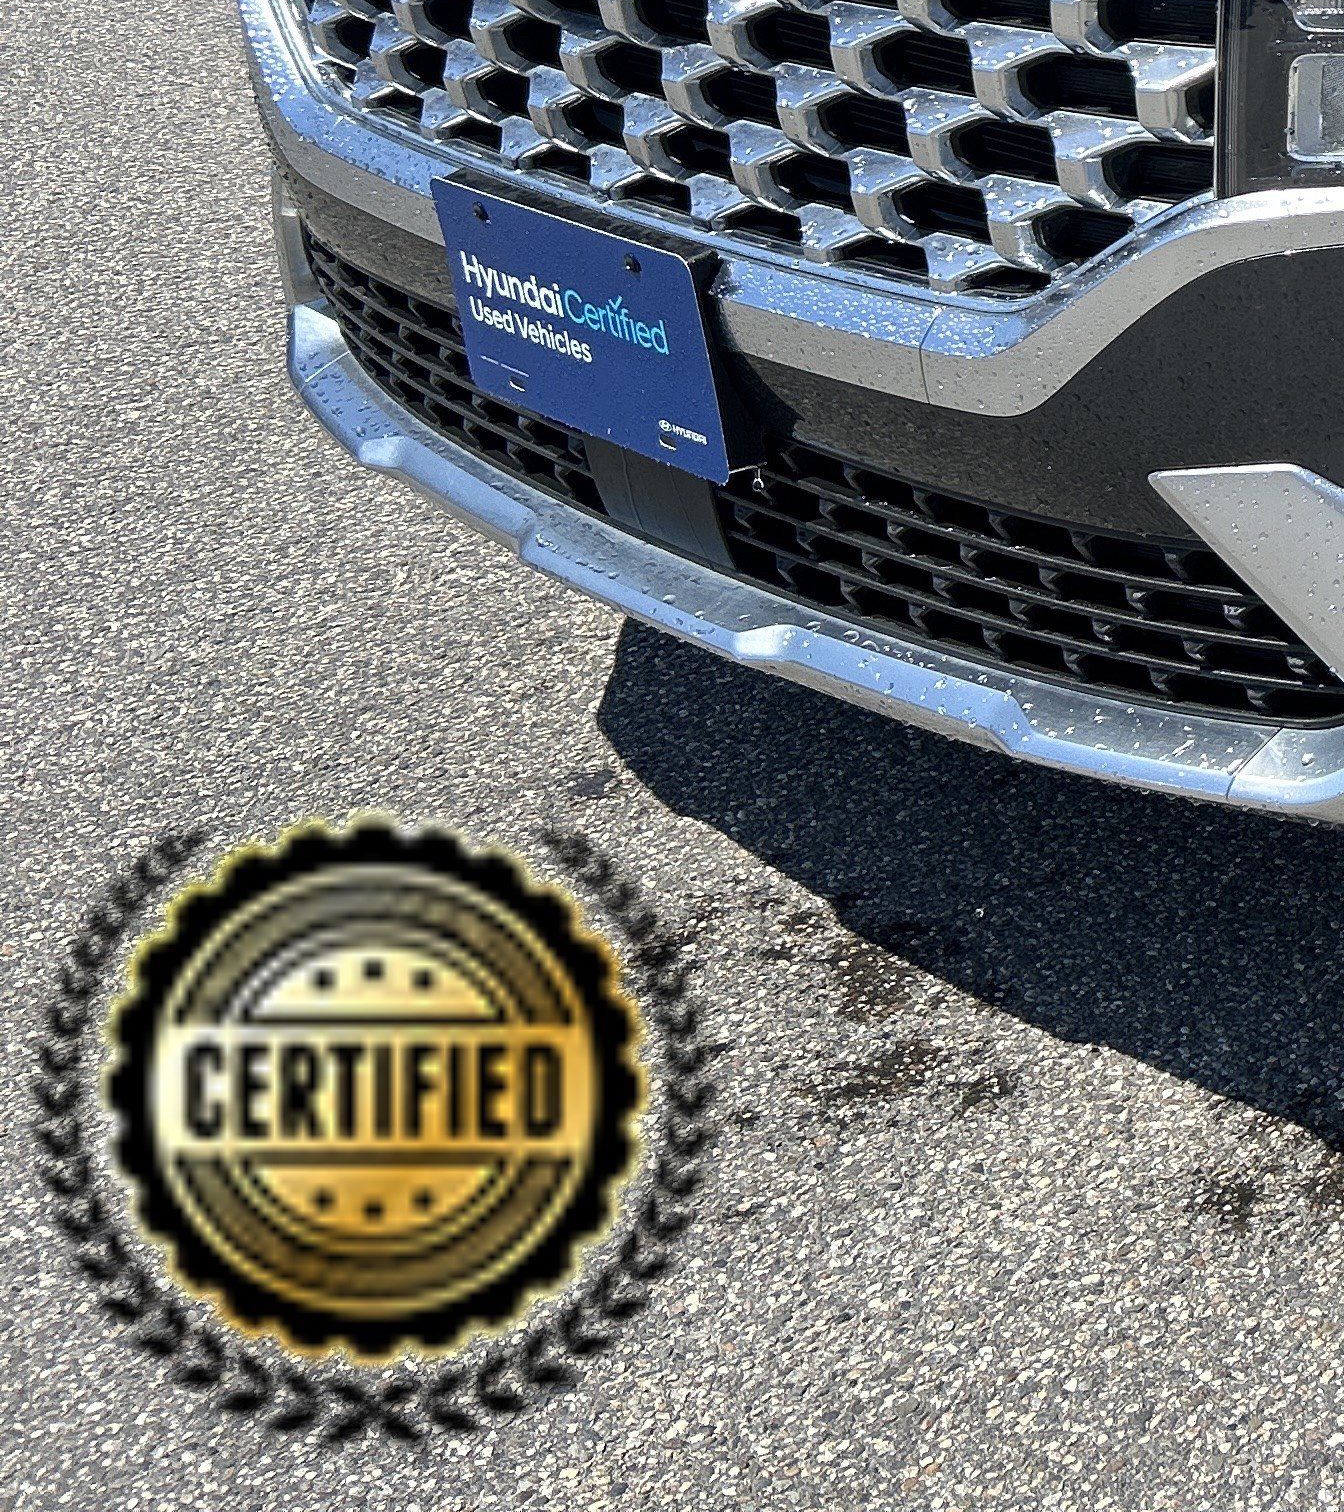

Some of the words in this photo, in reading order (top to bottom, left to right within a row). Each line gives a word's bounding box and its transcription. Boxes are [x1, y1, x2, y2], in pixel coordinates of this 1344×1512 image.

[460, 250, 564, 318] Hyundai
[564, 289, 670, 355] Certified
[469, 296, 515, 334] Used
[514, 313, 592, 363] Vehicles
